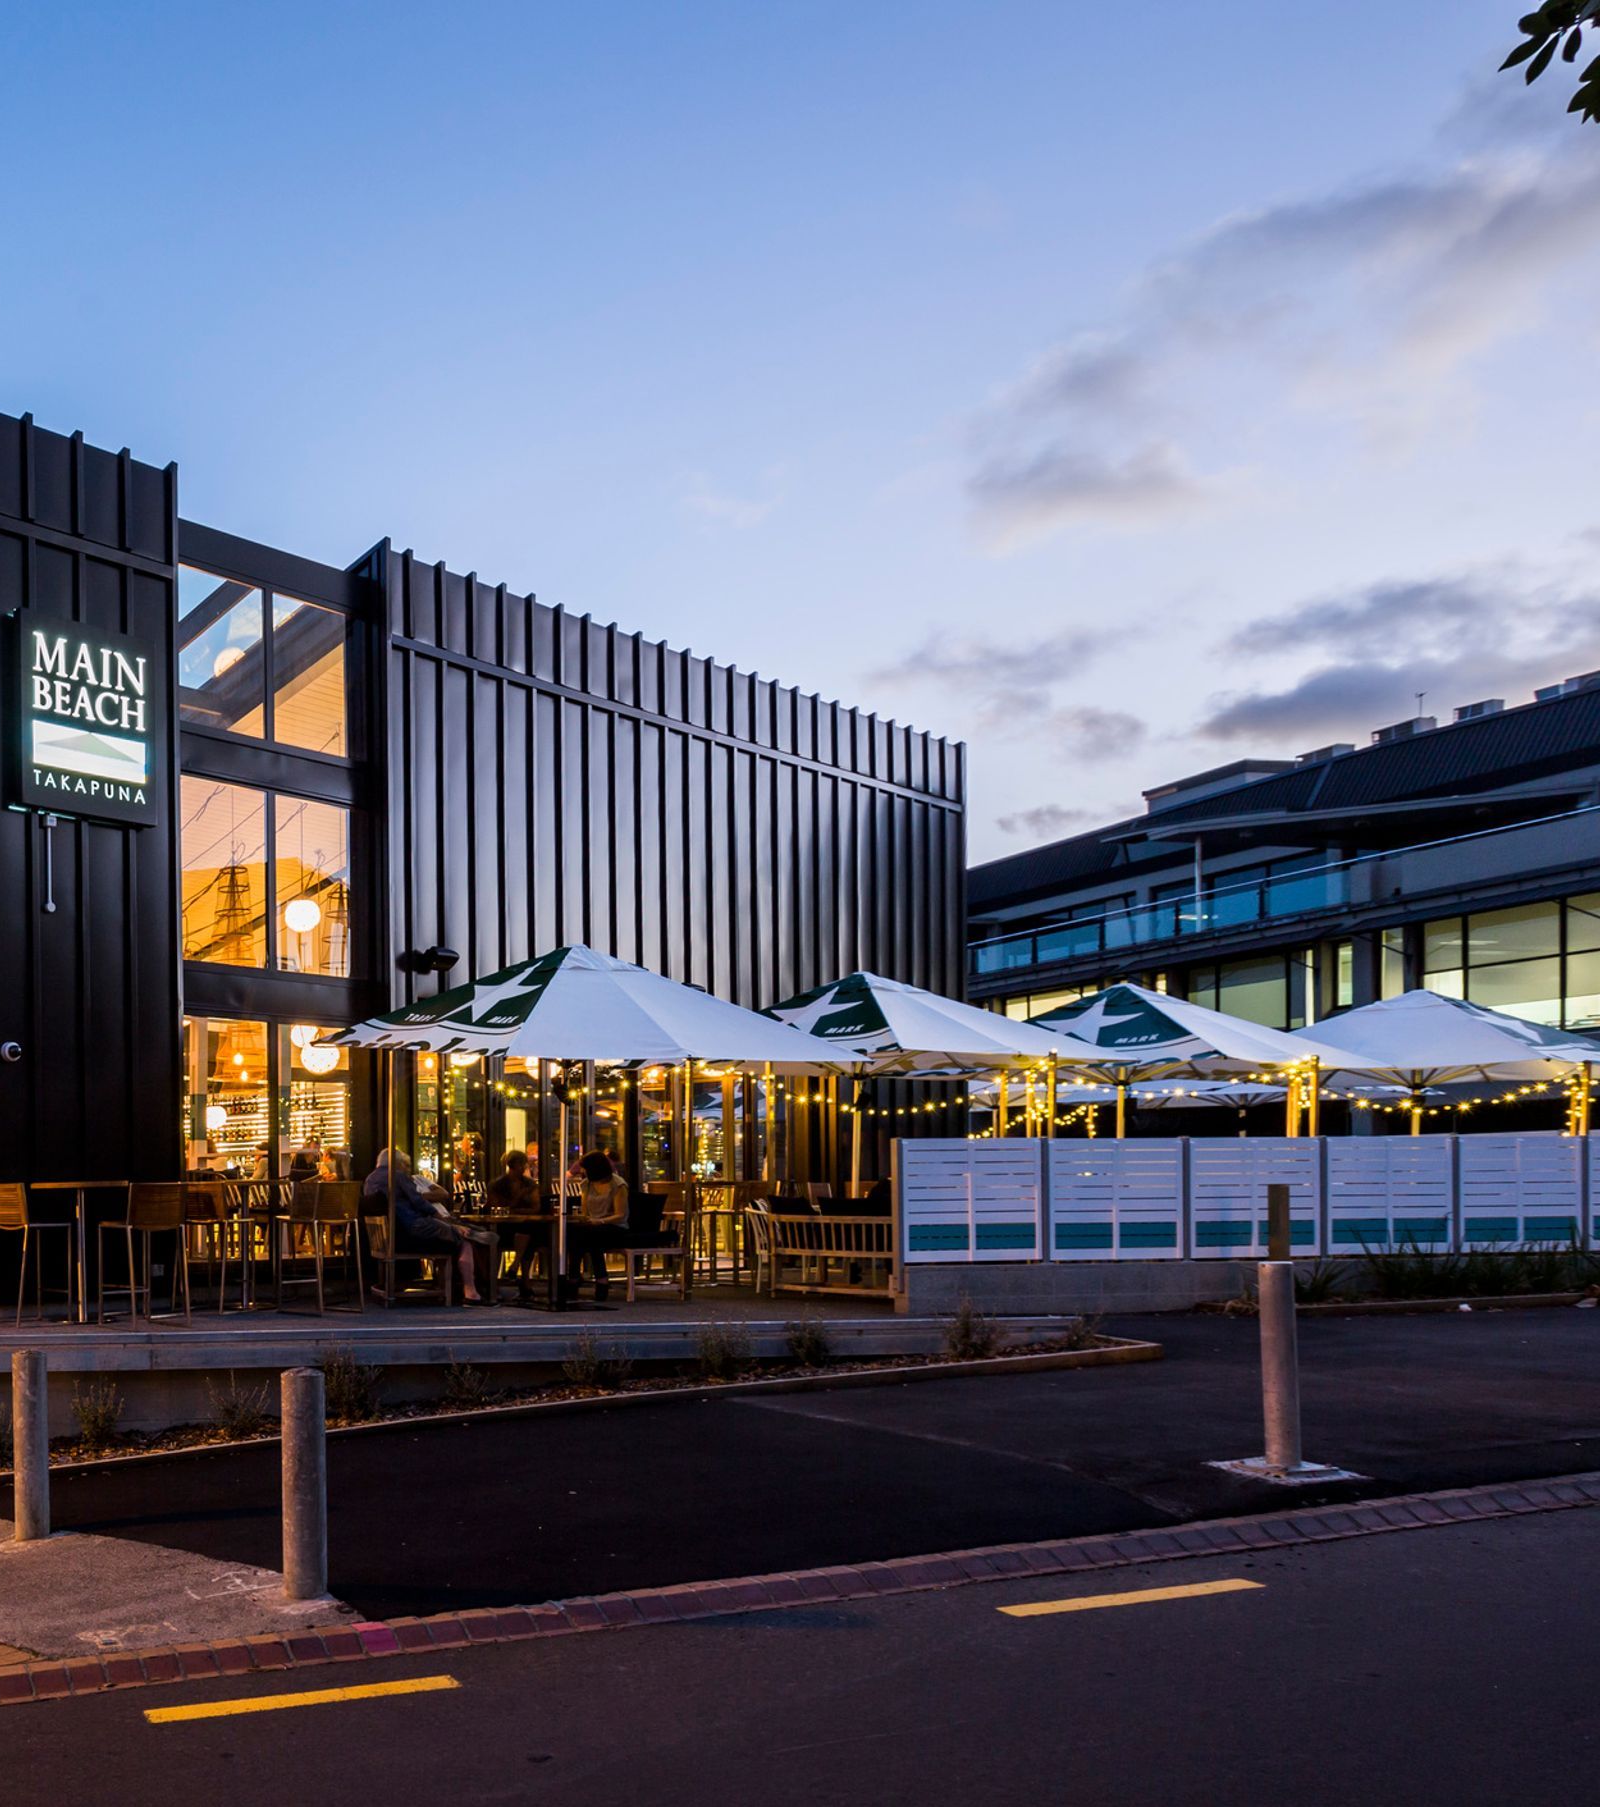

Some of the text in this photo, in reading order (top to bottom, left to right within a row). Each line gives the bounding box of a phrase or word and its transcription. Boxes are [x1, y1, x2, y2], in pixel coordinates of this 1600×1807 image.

[32, 630, 147, 696] MAIN
[32, 675, 146, 732] BEACH
[33, 769, 146, 805] TAKAPUNA
[824, 1023, 865, 1035] MARK
[1114, 1033, 1160, 1044] MARK
